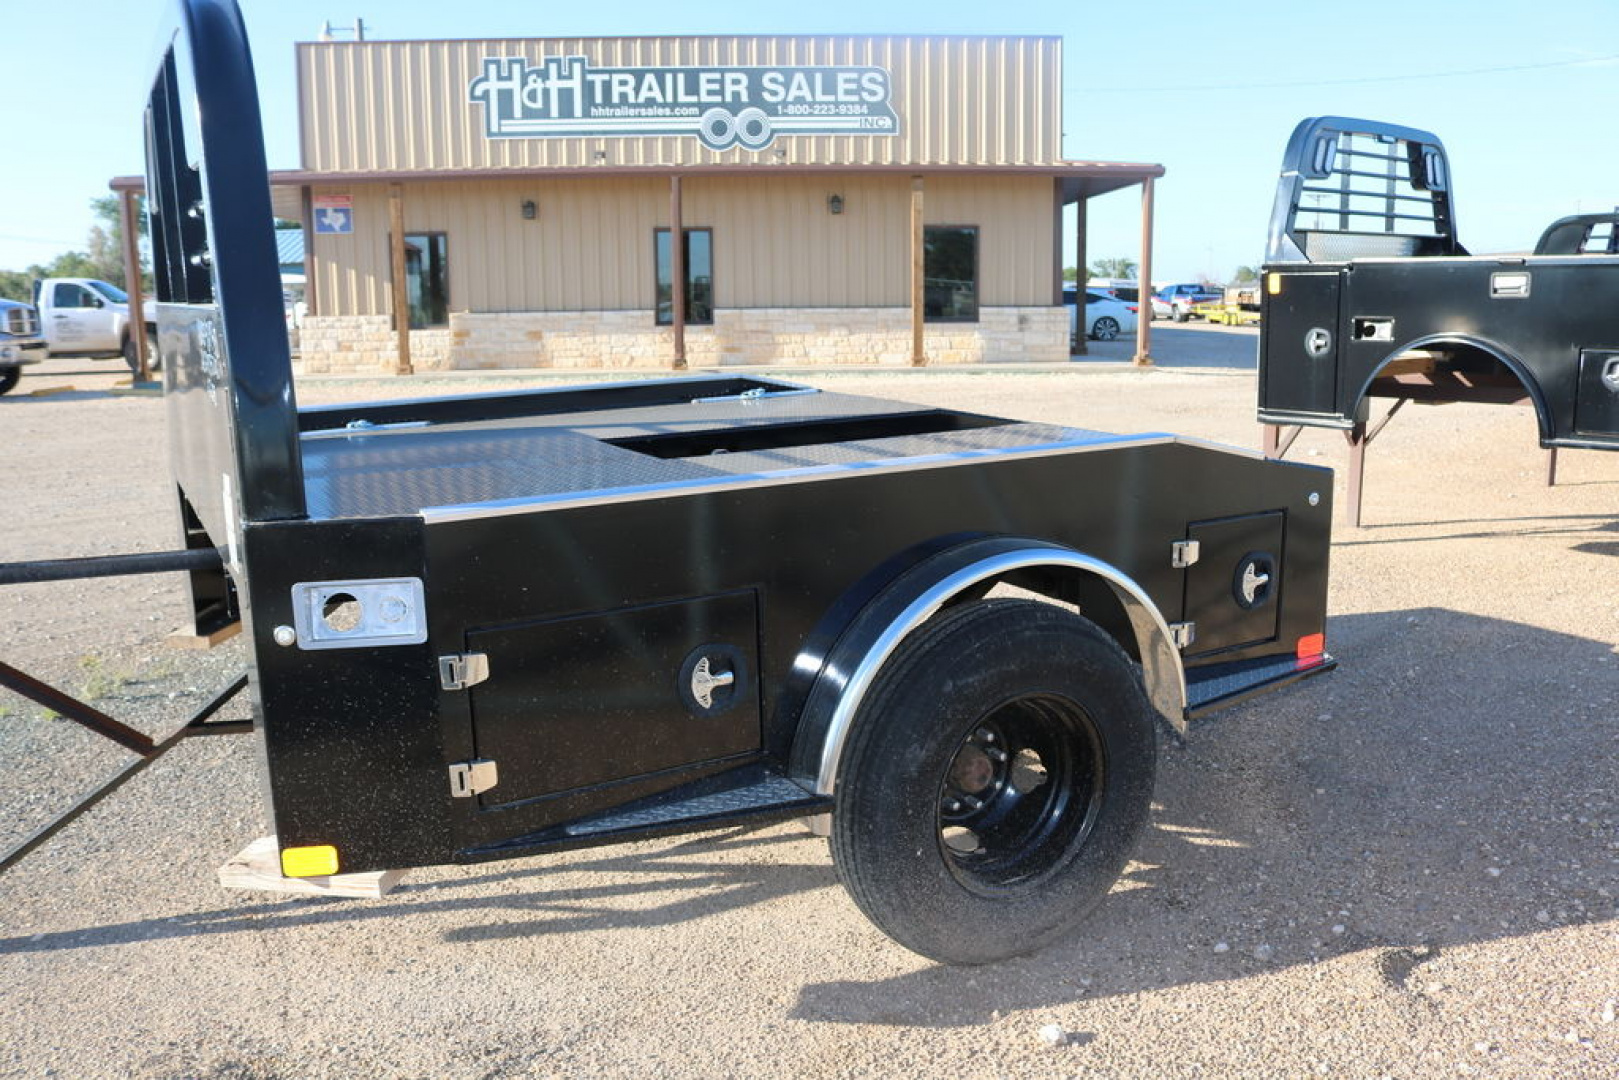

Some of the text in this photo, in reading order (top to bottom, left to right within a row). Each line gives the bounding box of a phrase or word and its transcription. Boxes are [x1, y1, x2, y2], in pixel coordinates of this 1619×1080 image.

[475, 63, 885, 132] H&H TRAILER SALES
[591, 105, 700, 117] hhtrailersales.com
[777, 104, 869, 115] 1-800-223-9384
